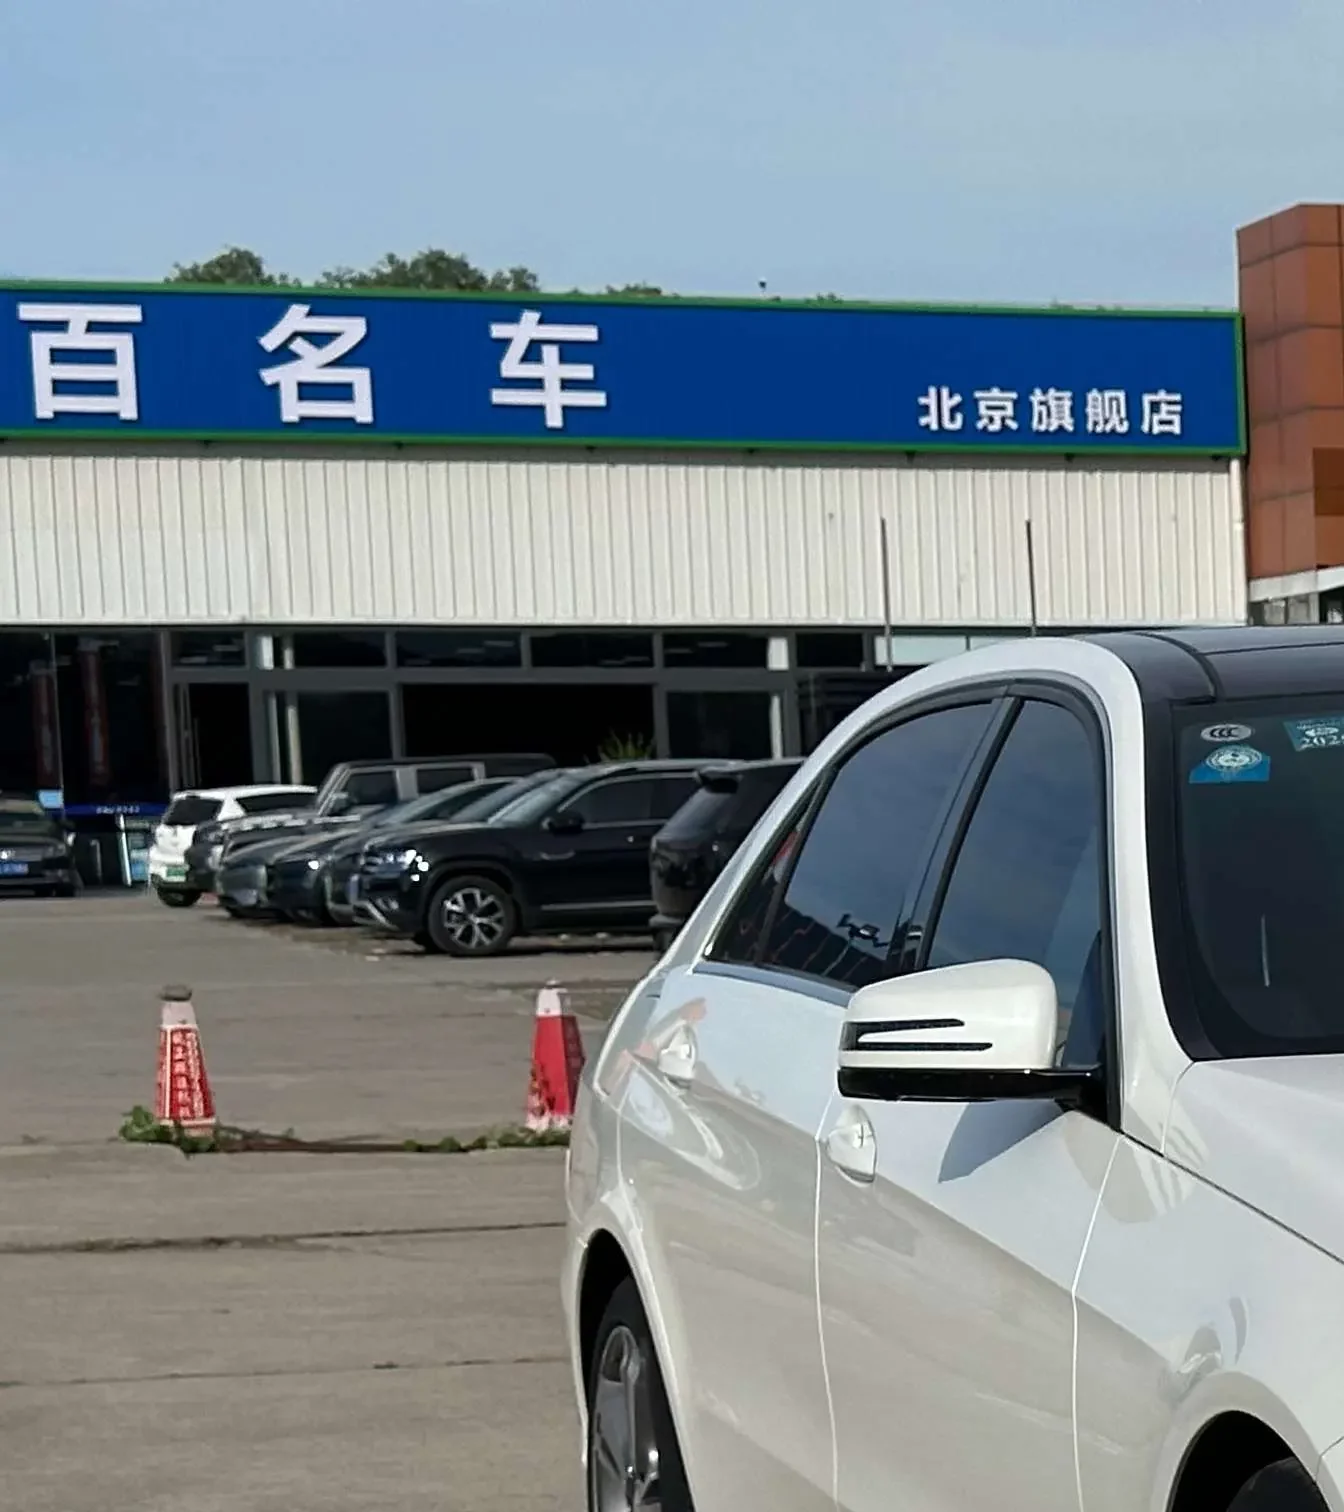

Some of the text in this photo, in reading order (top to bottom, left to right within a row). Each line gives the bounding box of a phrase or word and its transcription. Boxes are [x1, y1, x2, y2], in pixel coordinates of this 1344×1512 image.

[17, 302, 608, 429] 百名车
[917, 385, 1183, 435] 北京旗舰店
